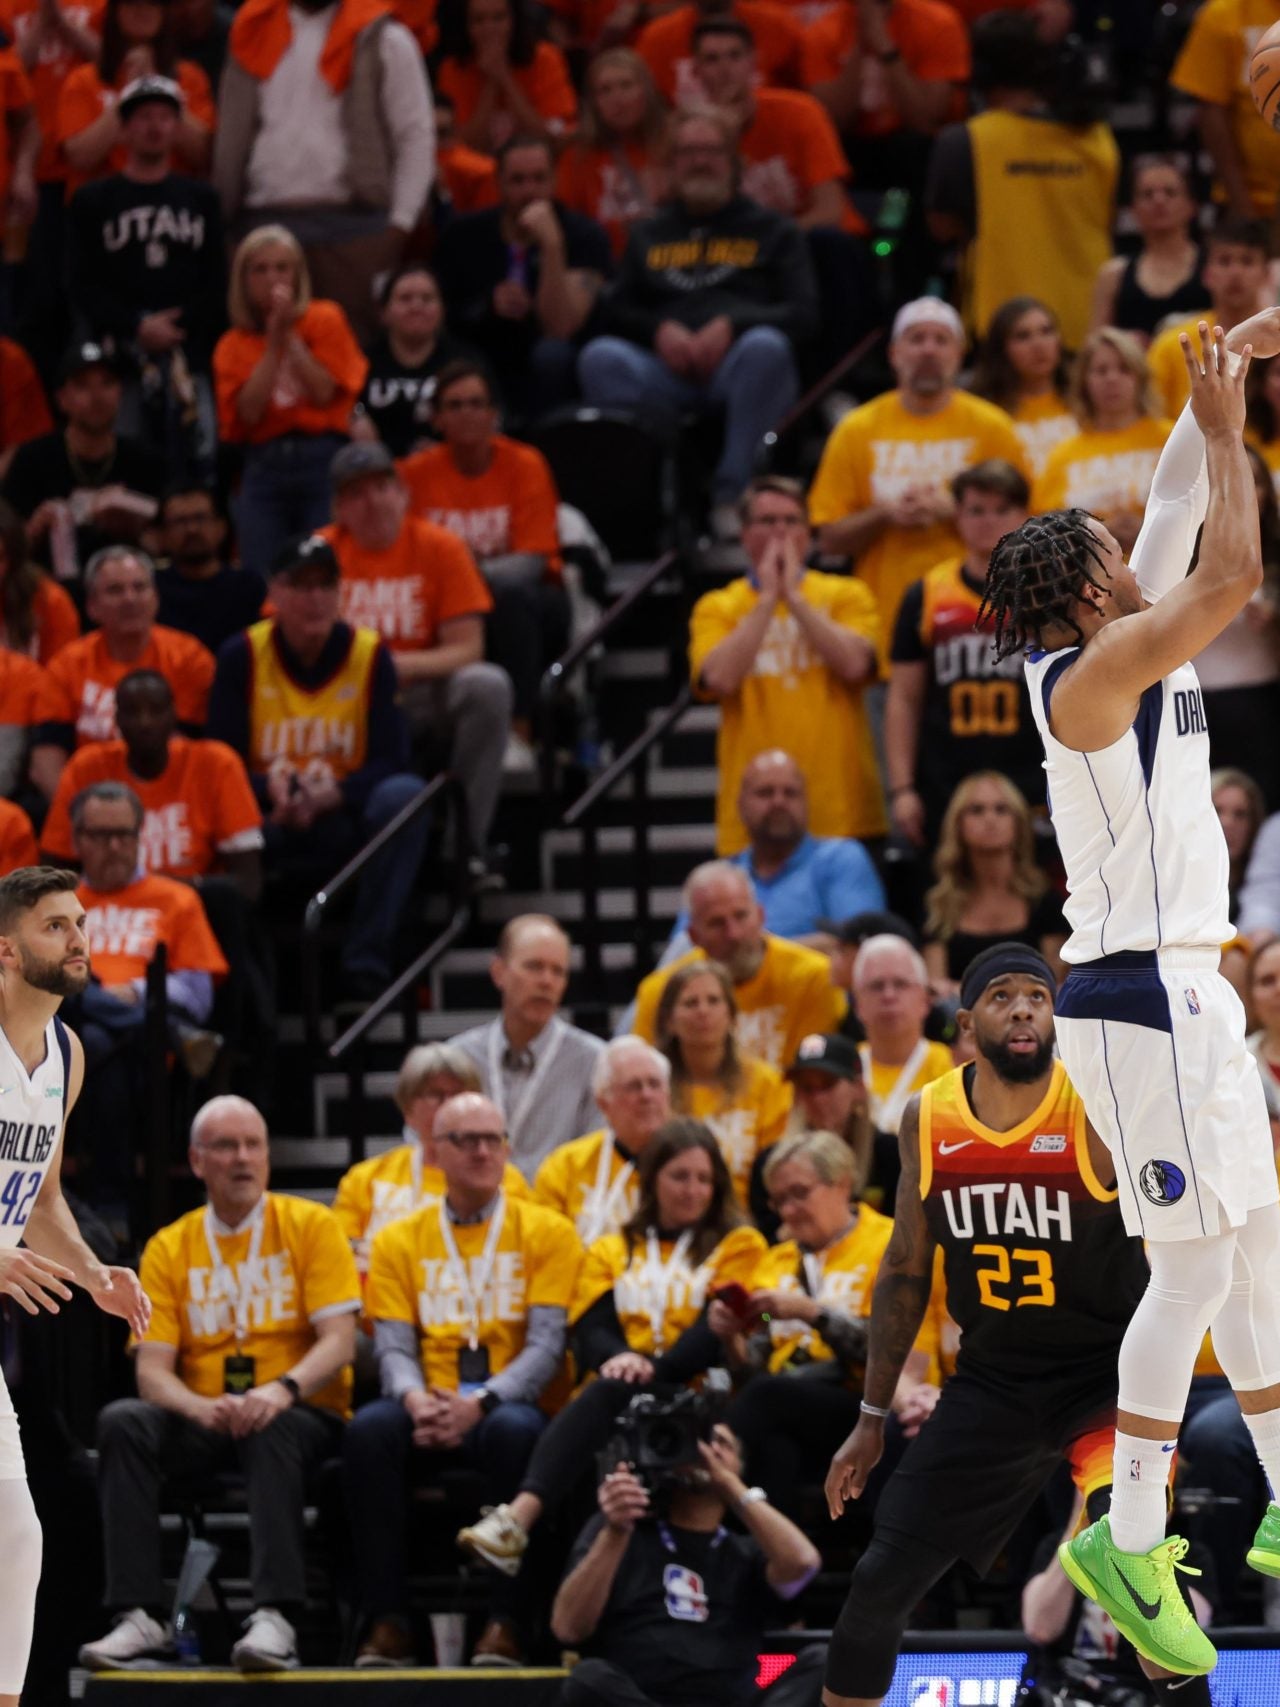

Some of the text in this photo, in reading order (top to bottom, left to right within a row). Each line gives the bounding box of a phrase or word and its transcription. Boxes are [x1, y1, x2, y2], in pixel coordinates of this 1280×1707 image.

[103, 205, 205, 252] UTAH
[950, 680, 1020, 737] 00
[1, 1170, 42, 1226] 42
[942, 1183, 1073, 1242] UTAH
[972, 1244, 1056, 1311] 23
